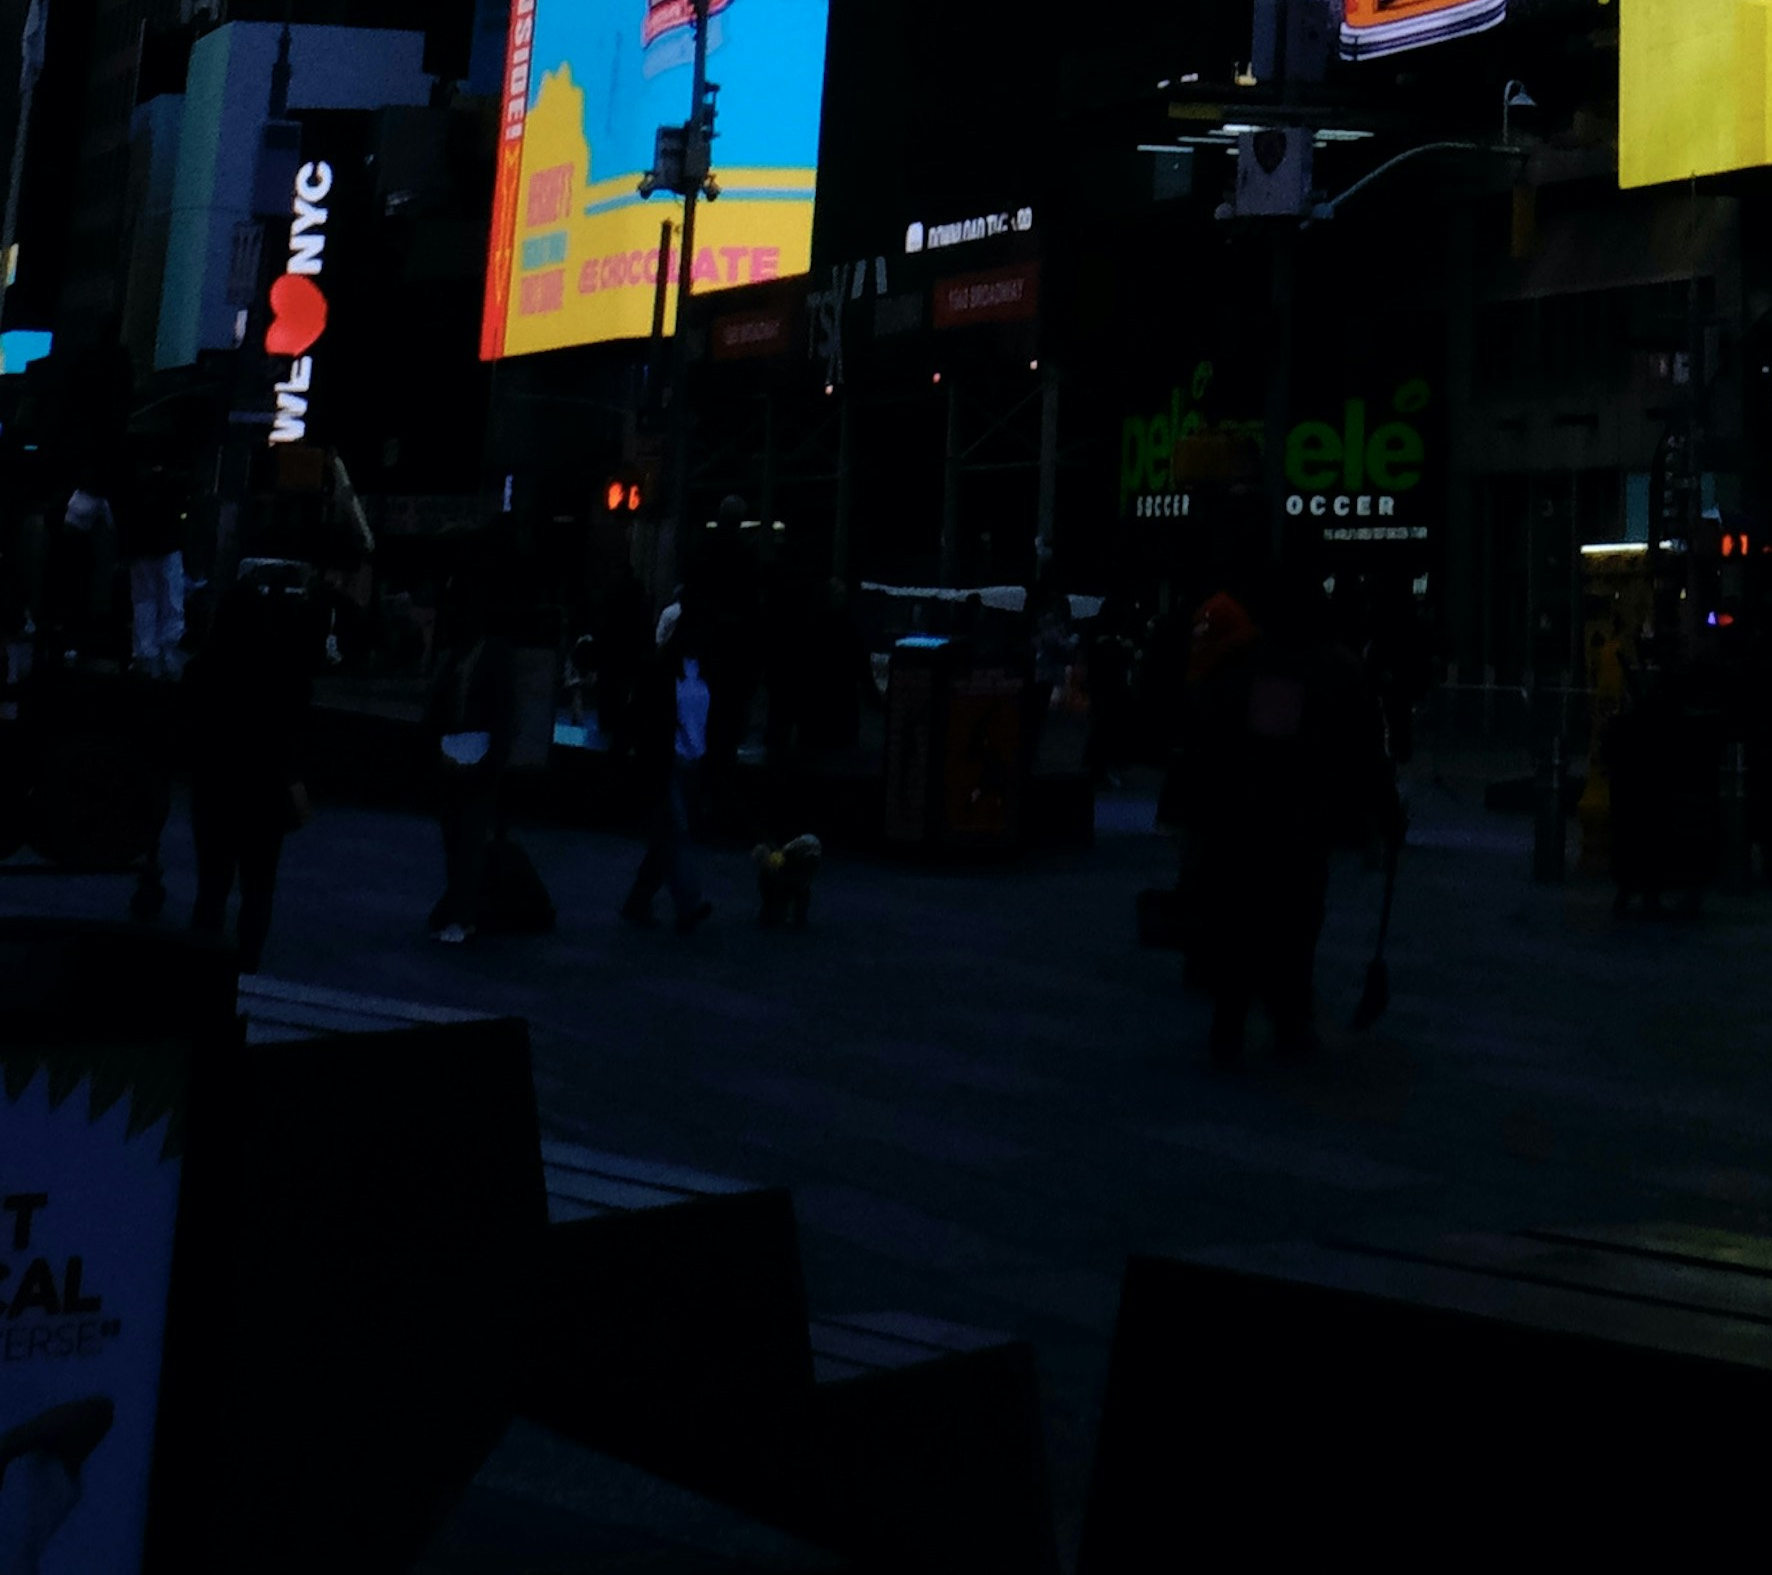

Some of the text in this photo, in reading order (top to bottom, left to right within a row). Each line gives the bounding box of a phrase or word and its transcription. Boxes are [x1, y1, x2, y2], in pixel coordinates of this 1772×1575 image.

[286, 159, 333, 276] NYC
[1136, 493, 1396, 518] SOCCER OCCER
[0, 1255, 102, 1320] AL
